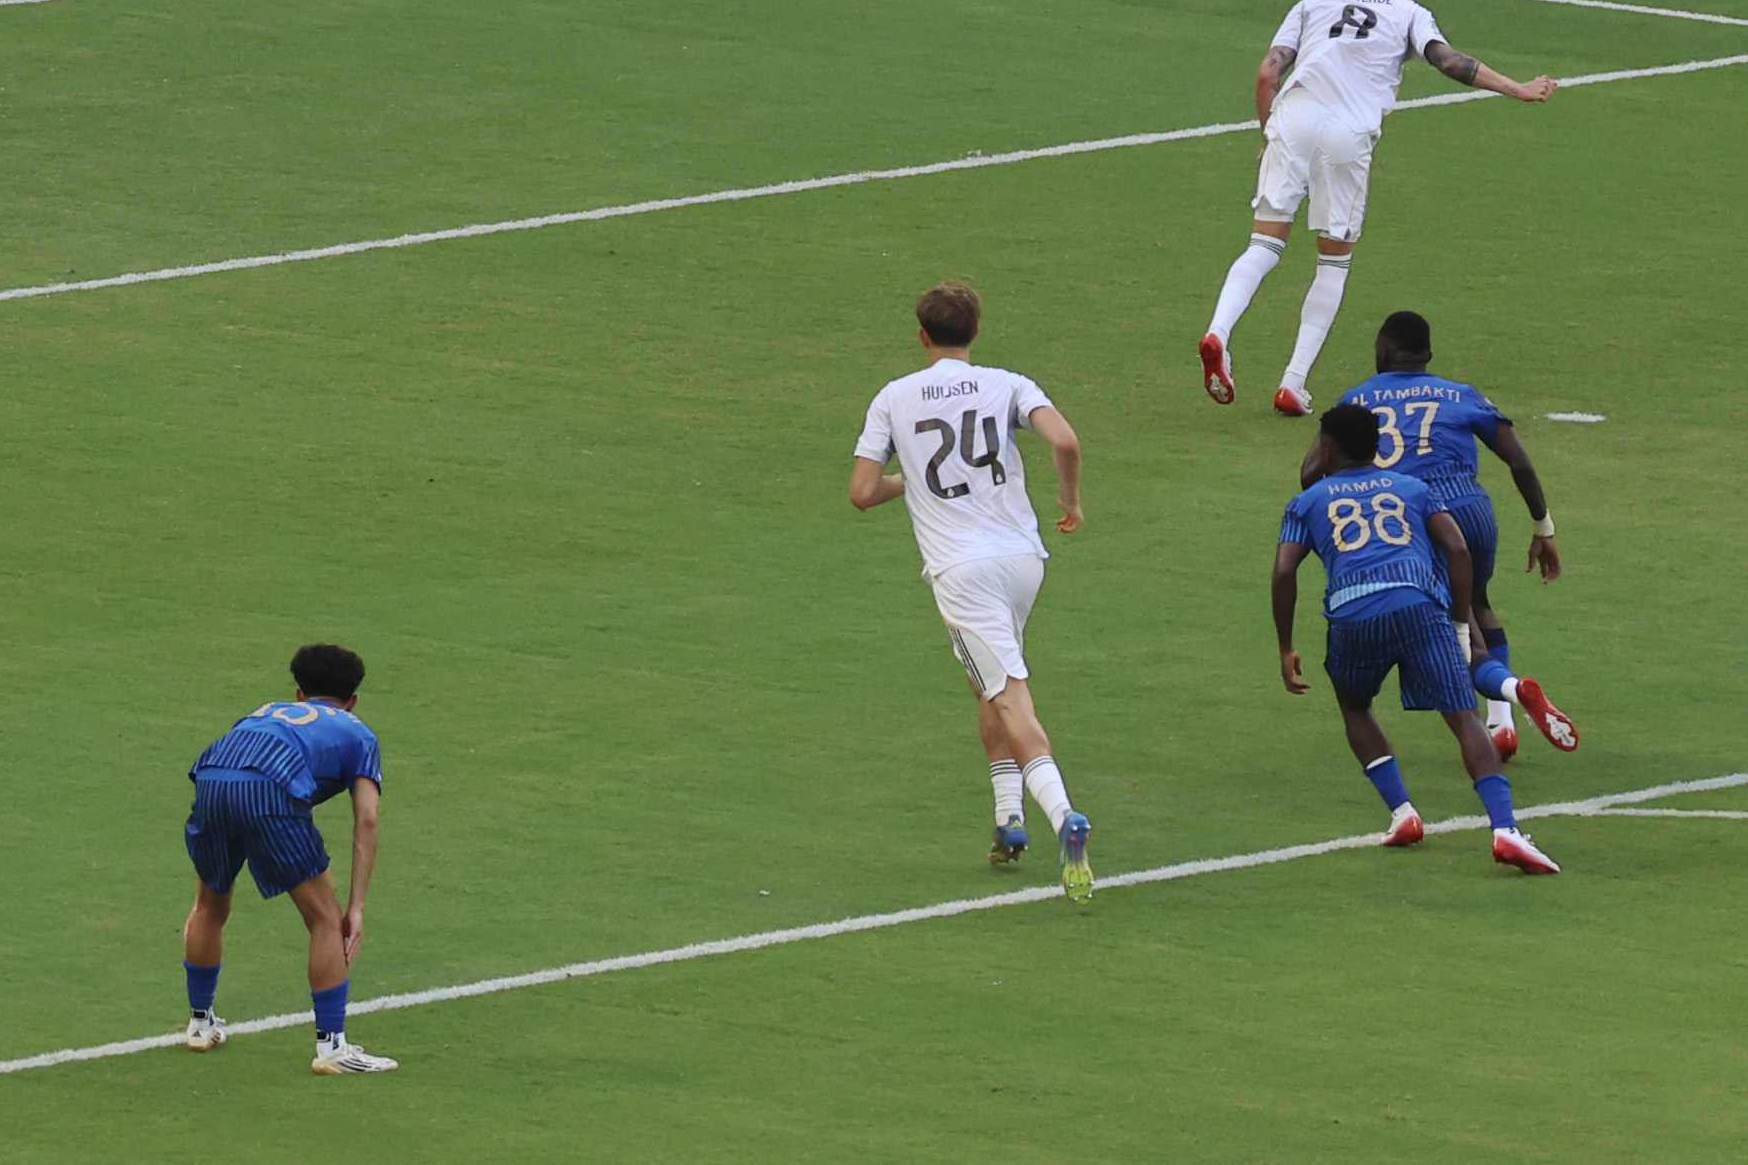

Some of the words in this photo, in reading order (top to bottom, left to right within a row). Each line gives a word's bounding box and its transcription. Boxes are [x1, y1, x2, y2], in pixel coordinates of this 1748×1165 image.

[1373, 386, 1461, 404] TAMBAKTI
[914, 409, 1006, 500] 24
[1328, 477, 1393, 495] HAMAD
[1327, 492, 1412, 553] 88
